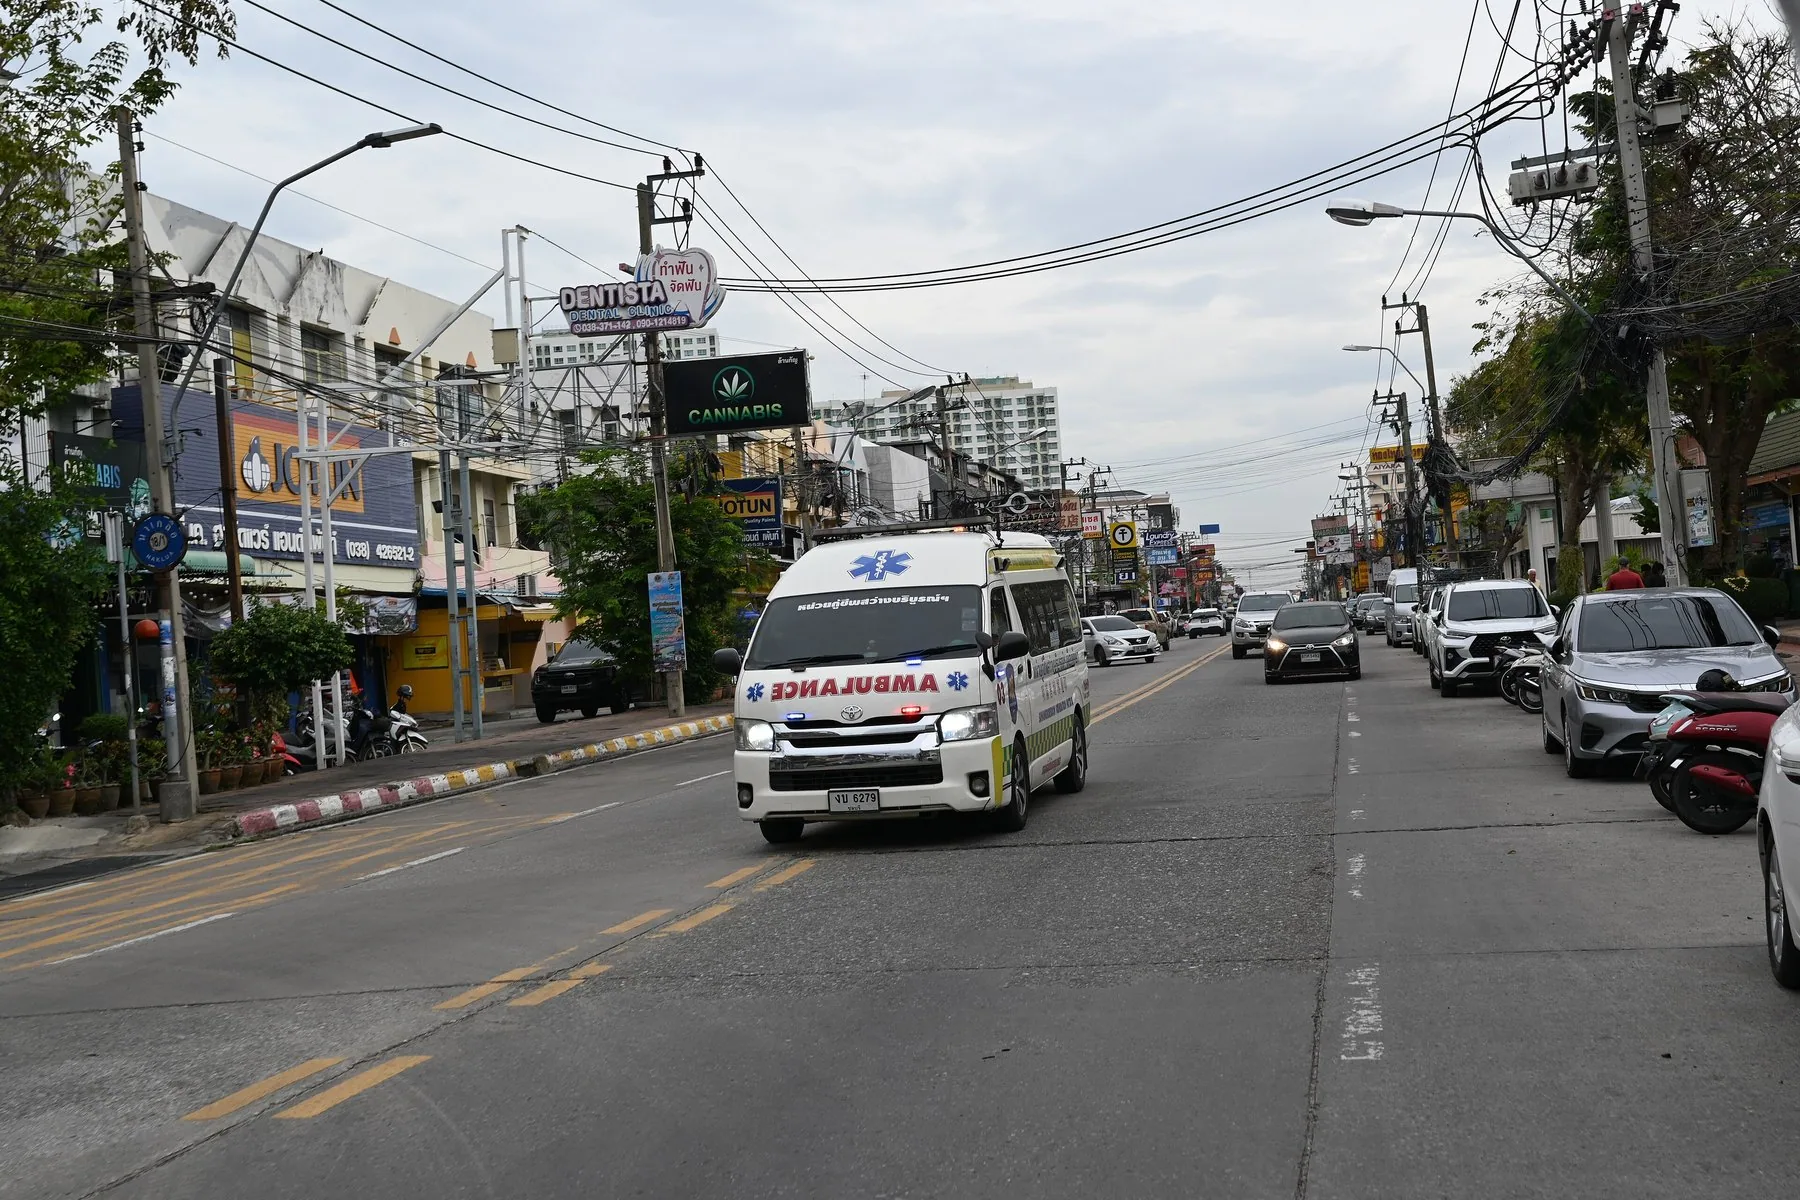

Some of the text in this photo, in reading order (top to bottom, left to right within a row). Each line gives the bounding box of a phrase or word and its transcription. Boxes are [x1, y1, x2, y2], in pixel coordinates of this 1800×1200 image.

[659, 261, 694, 277] ทำฟัน
[669, 278, 702, 294] จัดฟัน
[561, 281, 668, 311] DENTISTA
[569, 303, 674, 322] DENTAL CLINIC
[636, 316, 687, 330] 090-1214819
[688, 403, 783, 425] CANNABIS
[1373, 463, 1402, 471] AIYARA
[719, 498, 772, 516] OTUN
[1145, 532, 1175, 541] Laundry
[145, 551, 174, 563] NAKLUA
[345, 538, 415, 562] (038) 426521-2
[996, 681, 1006, 706] 03
[853, 792, 877, 804] 6279
